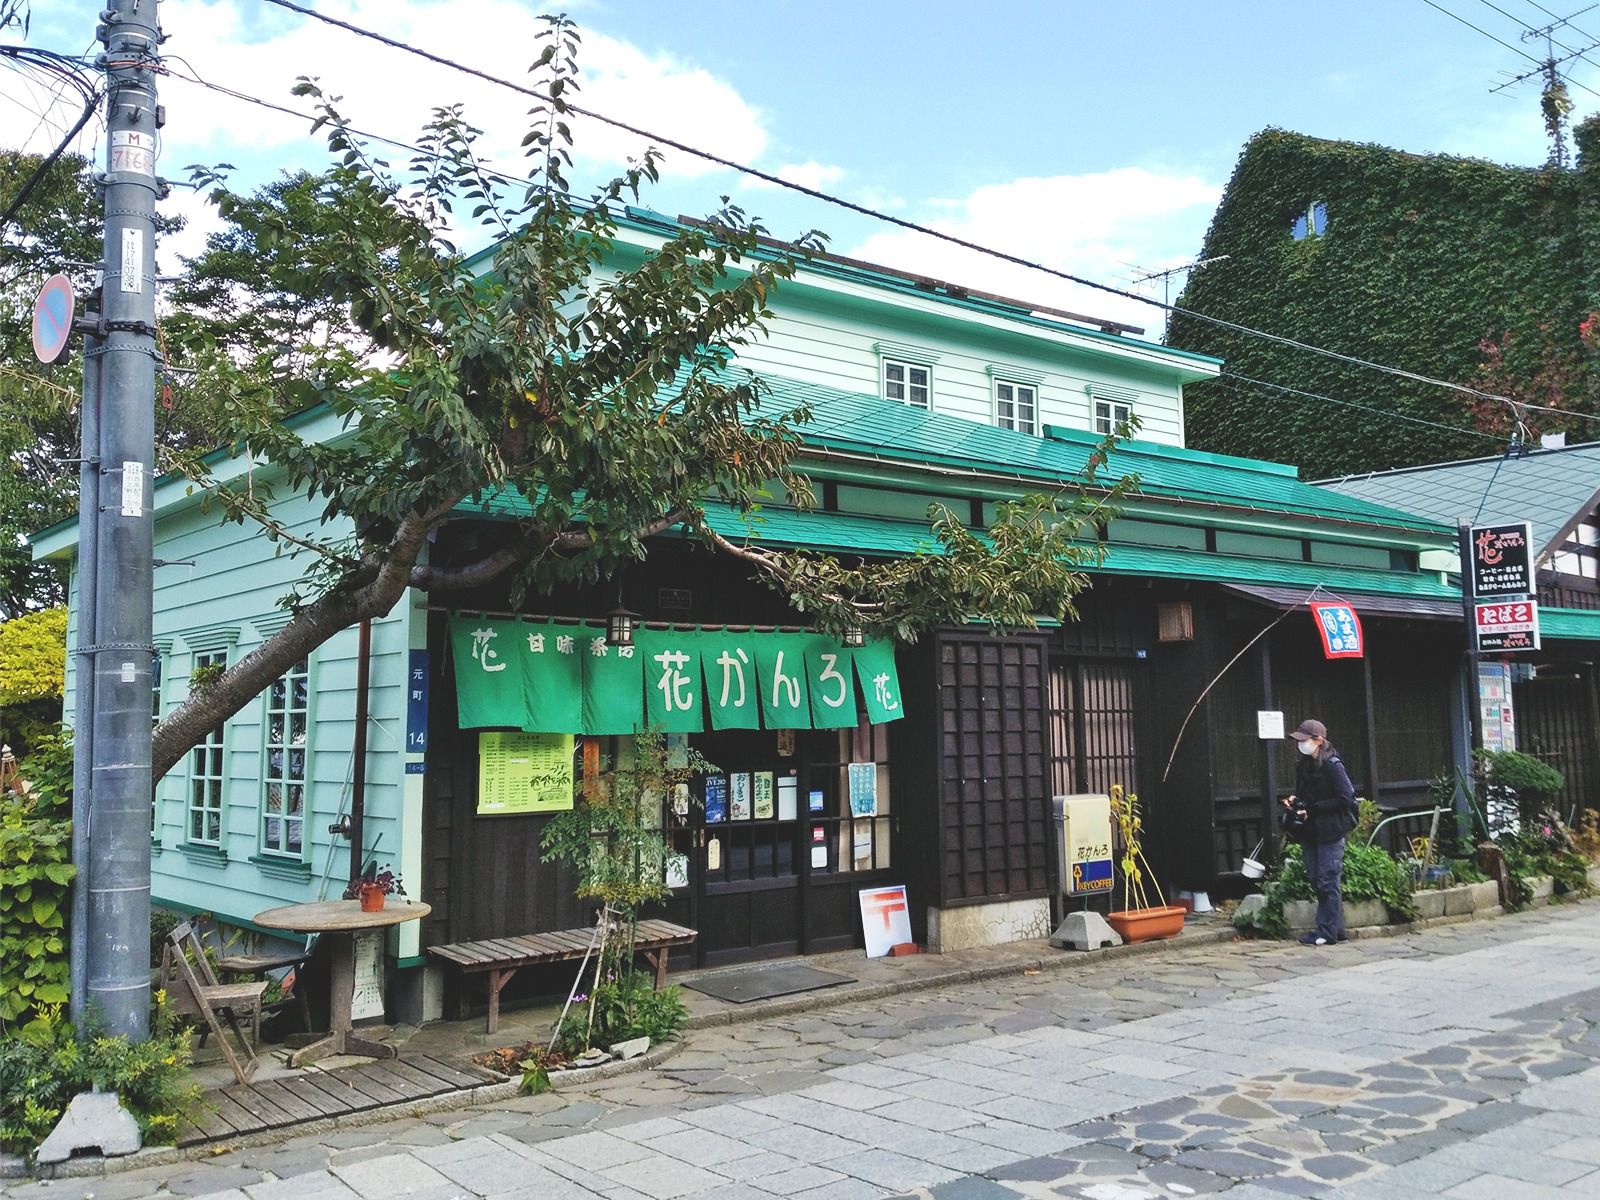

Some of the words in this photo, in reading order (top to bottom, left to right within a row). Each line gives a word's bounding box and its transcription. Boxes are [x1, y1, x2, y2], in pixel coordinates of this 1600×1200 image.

[128, 133, 140, 145] M
[1337, 609, 1358, 649] あま酒
[1482, 605, 1528, 624] たばこ
[470, 627, 507, 672] 花
[412, 668, 424, 701] 元町
[653, 648, 847, 712] 花かんろ
[873, 672, 898, 711] 花
[409, 732, 425, 745] 14
[1077, 844, 1109, 859] 花かんろ
